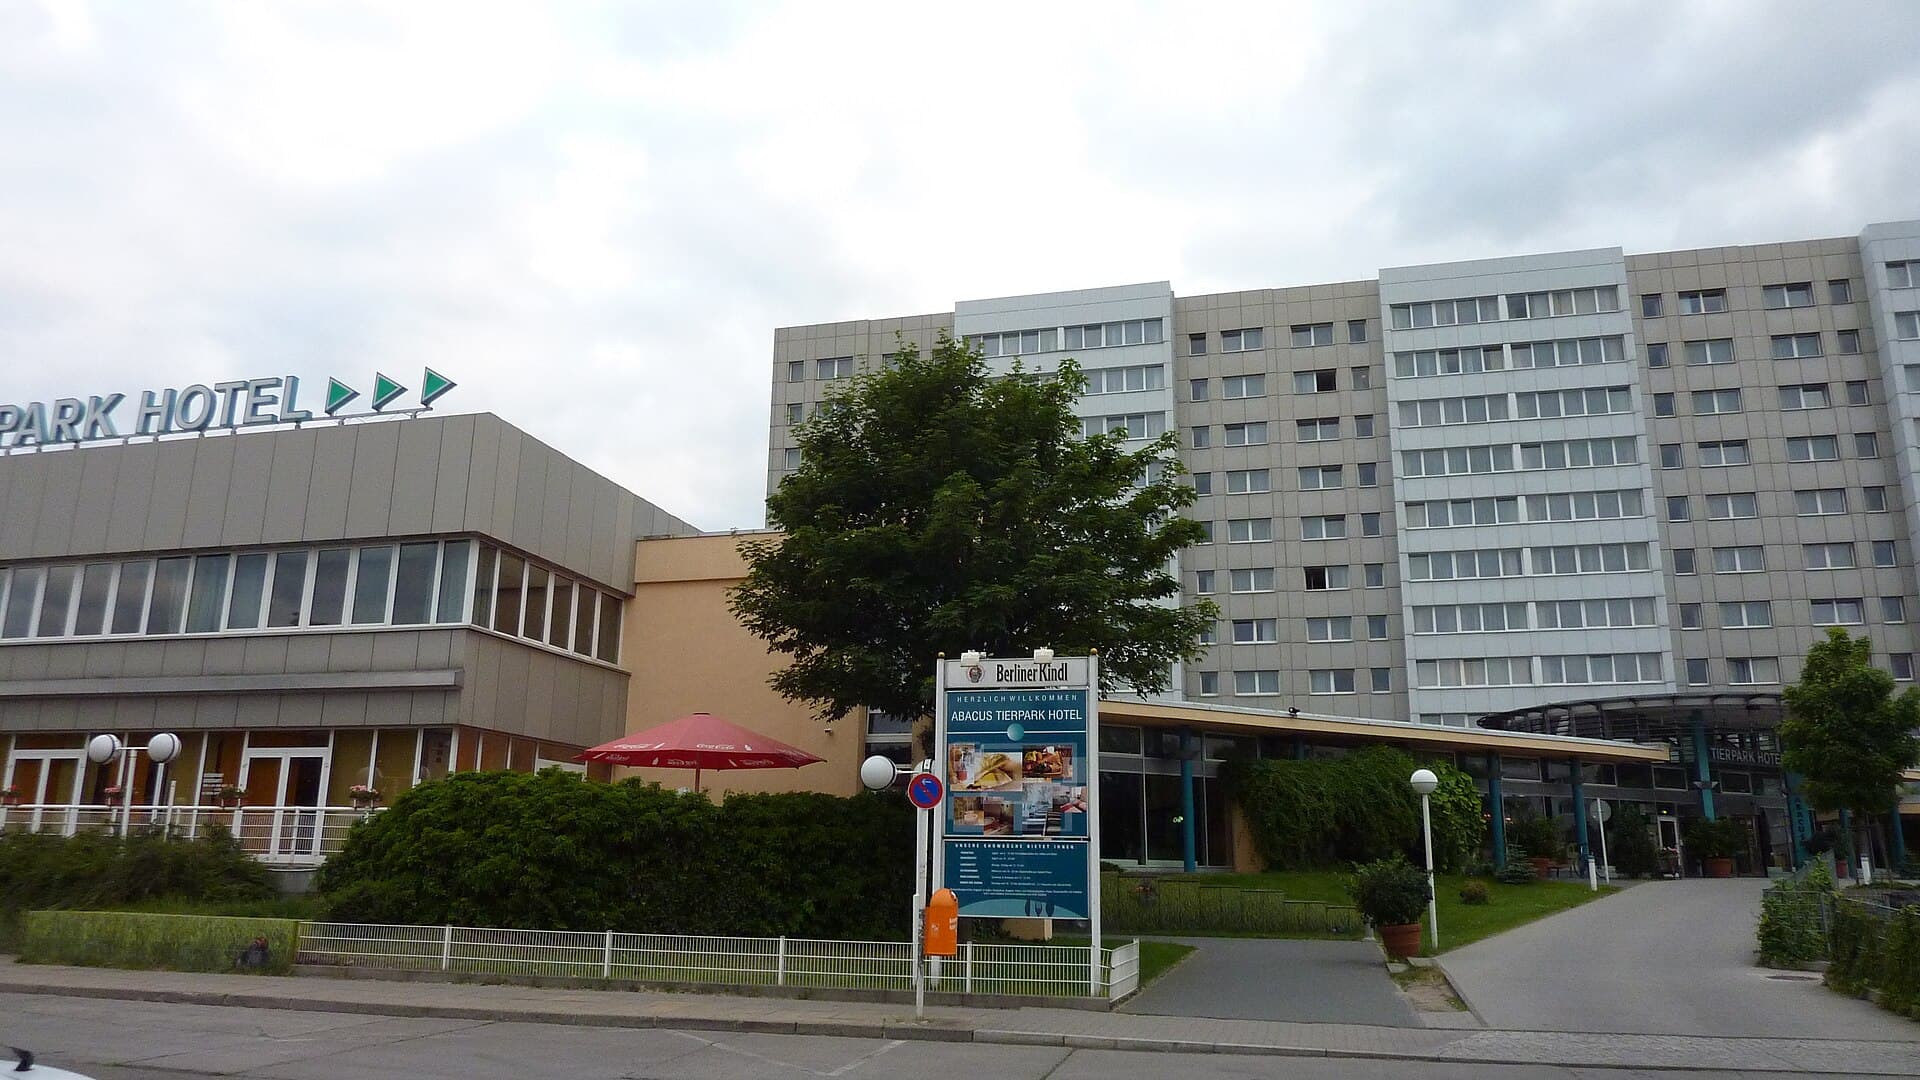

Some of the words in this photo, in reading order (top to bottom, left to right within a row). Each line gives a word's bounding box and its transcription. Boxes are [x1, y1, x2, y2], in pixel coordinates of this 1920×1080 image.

[0, 392, 126, 448] PARK
[135, 375, 313, 436] HOTEL
[996, 664, 1038, 683] Berliner
[1039, 662, 1068, 682] Kindl
[1009, 694, 1077, 702] WILLKOMMEN
[951, 710, 993, 722] ABACUS
[995, 709, 1046, 721] TIERPARK
[1048, 709, 1082, 720] HOTEL
[1710, 747, 1756, 764] TIERPARK
[1757, 751, 1783, 765] HOTE
